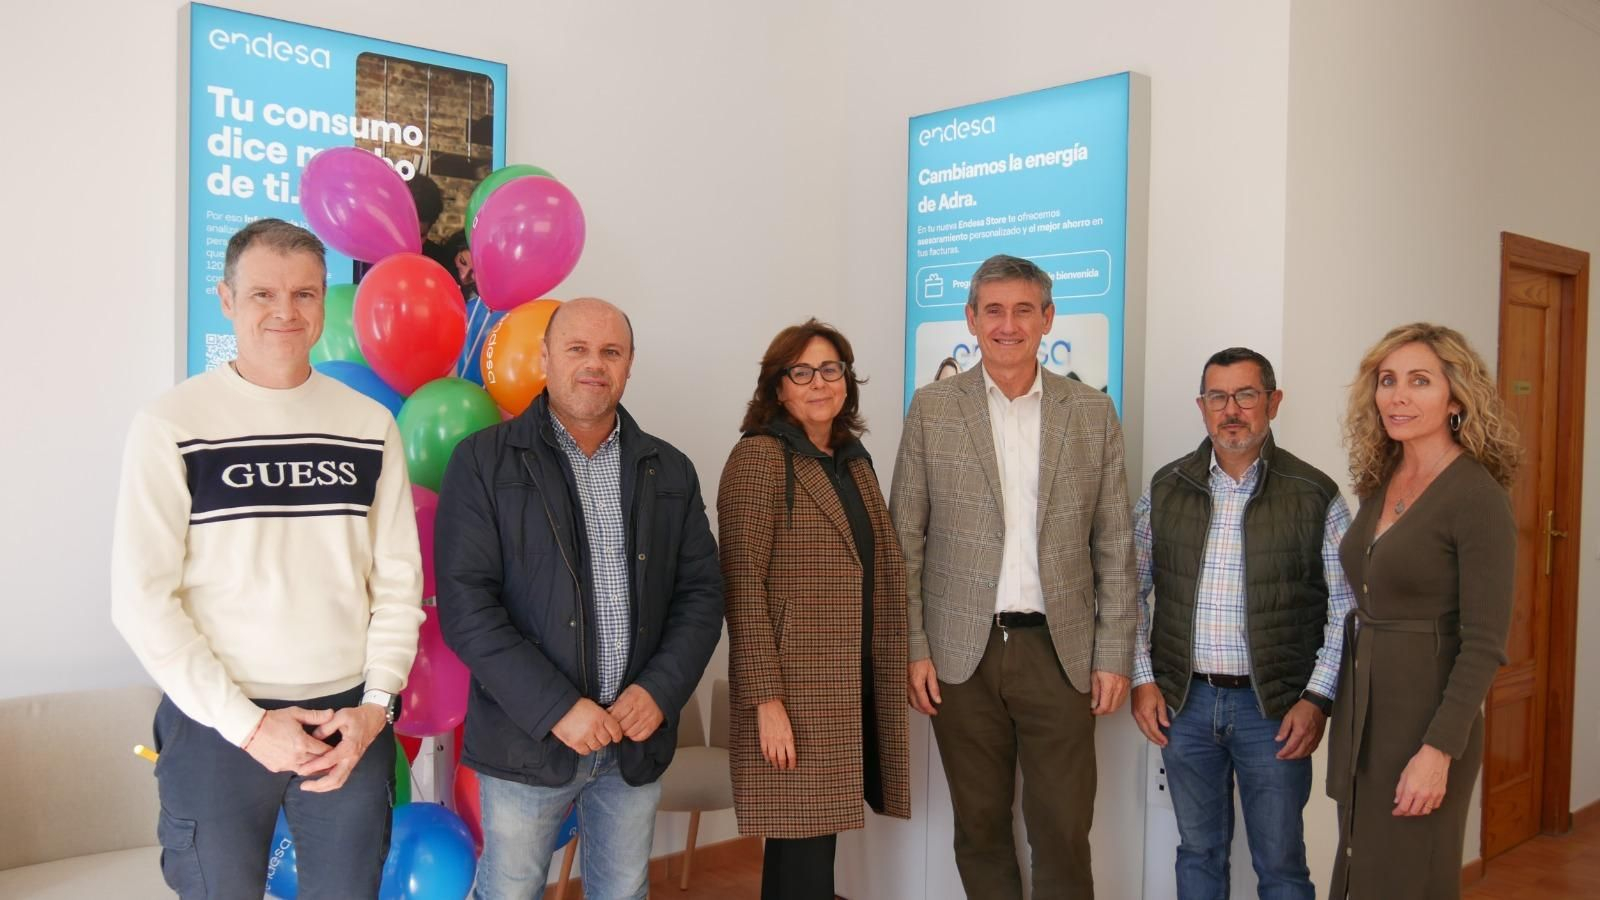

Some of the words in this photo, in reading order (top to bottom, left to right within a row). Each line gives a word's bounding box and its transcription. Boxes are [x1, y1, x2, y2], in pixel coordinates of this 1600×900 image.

[208, 28, 331, 69] endesa
[207, 85, 254, 122] Tu
[263, 102, 424, 147] consumo
[918, 114, 997, 146] endesa
[207, 126, 288, 165] dice
[918, 159, 1007, 186] Cambiamos
[1008, 153, 1023, 172] la
[1025, 143, 1088, 168] energía
[207, 165, 255, 198] de
[262, 171, 300, 204] ti.
[917, 195, 937, 213] de
[938, 191, 977, 211] Adra.
[917, 225, 927, 234] En
[928, 225, 935, 233] tu
[936, 222, 957, 232] nueva
[958, 218, 985, 230] Endesa
[985, 215, 1007, 226] Store
[1008, 214, 1016, 223] te
[1017, 209, 1061, 222] ofrecemos
[917, 232, 968, 246] asesoramiento
[969, 225, 1021, 242] personalizado
[1028, 223, 1036, 233] el
[1037, 221, 1061, 233] mejor
[1062, 219, 1091, 230] ahorro
[1092, 217, 1104, 226] en
[917, 249, 929, 257] tus
[1056, 267, 1099, 281] bienvenida
[221, 460, 358, 488] GUESS
